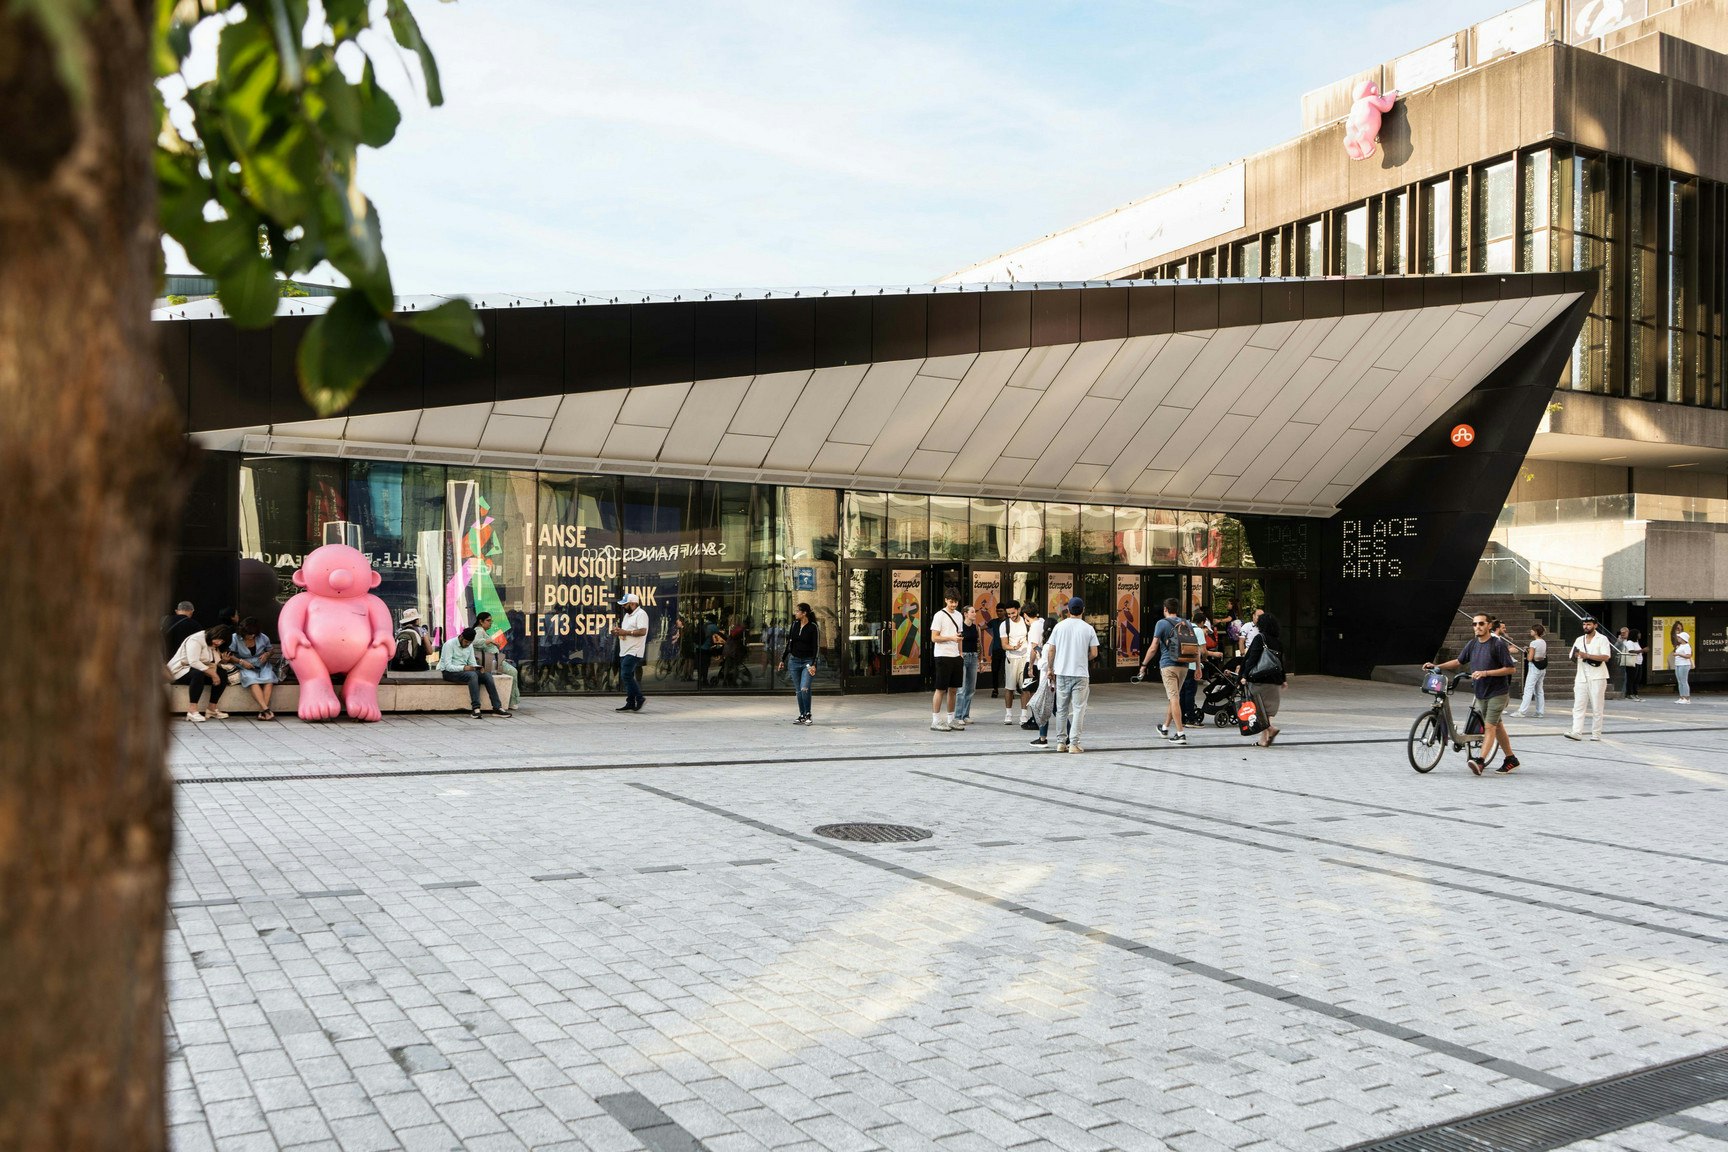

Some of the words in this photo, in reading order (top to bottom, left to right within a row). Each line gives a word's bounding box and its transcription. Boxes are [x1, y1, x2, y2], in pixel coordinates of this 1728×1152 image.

[1343, 517, 1418, 538] PLACE
[1343, 539, 1387, 558] DES
[551, 555, 627, 581] MUSIQU
[1343, 559, 1402, 578] ARTS
[550, 613, 570, 635] 13
